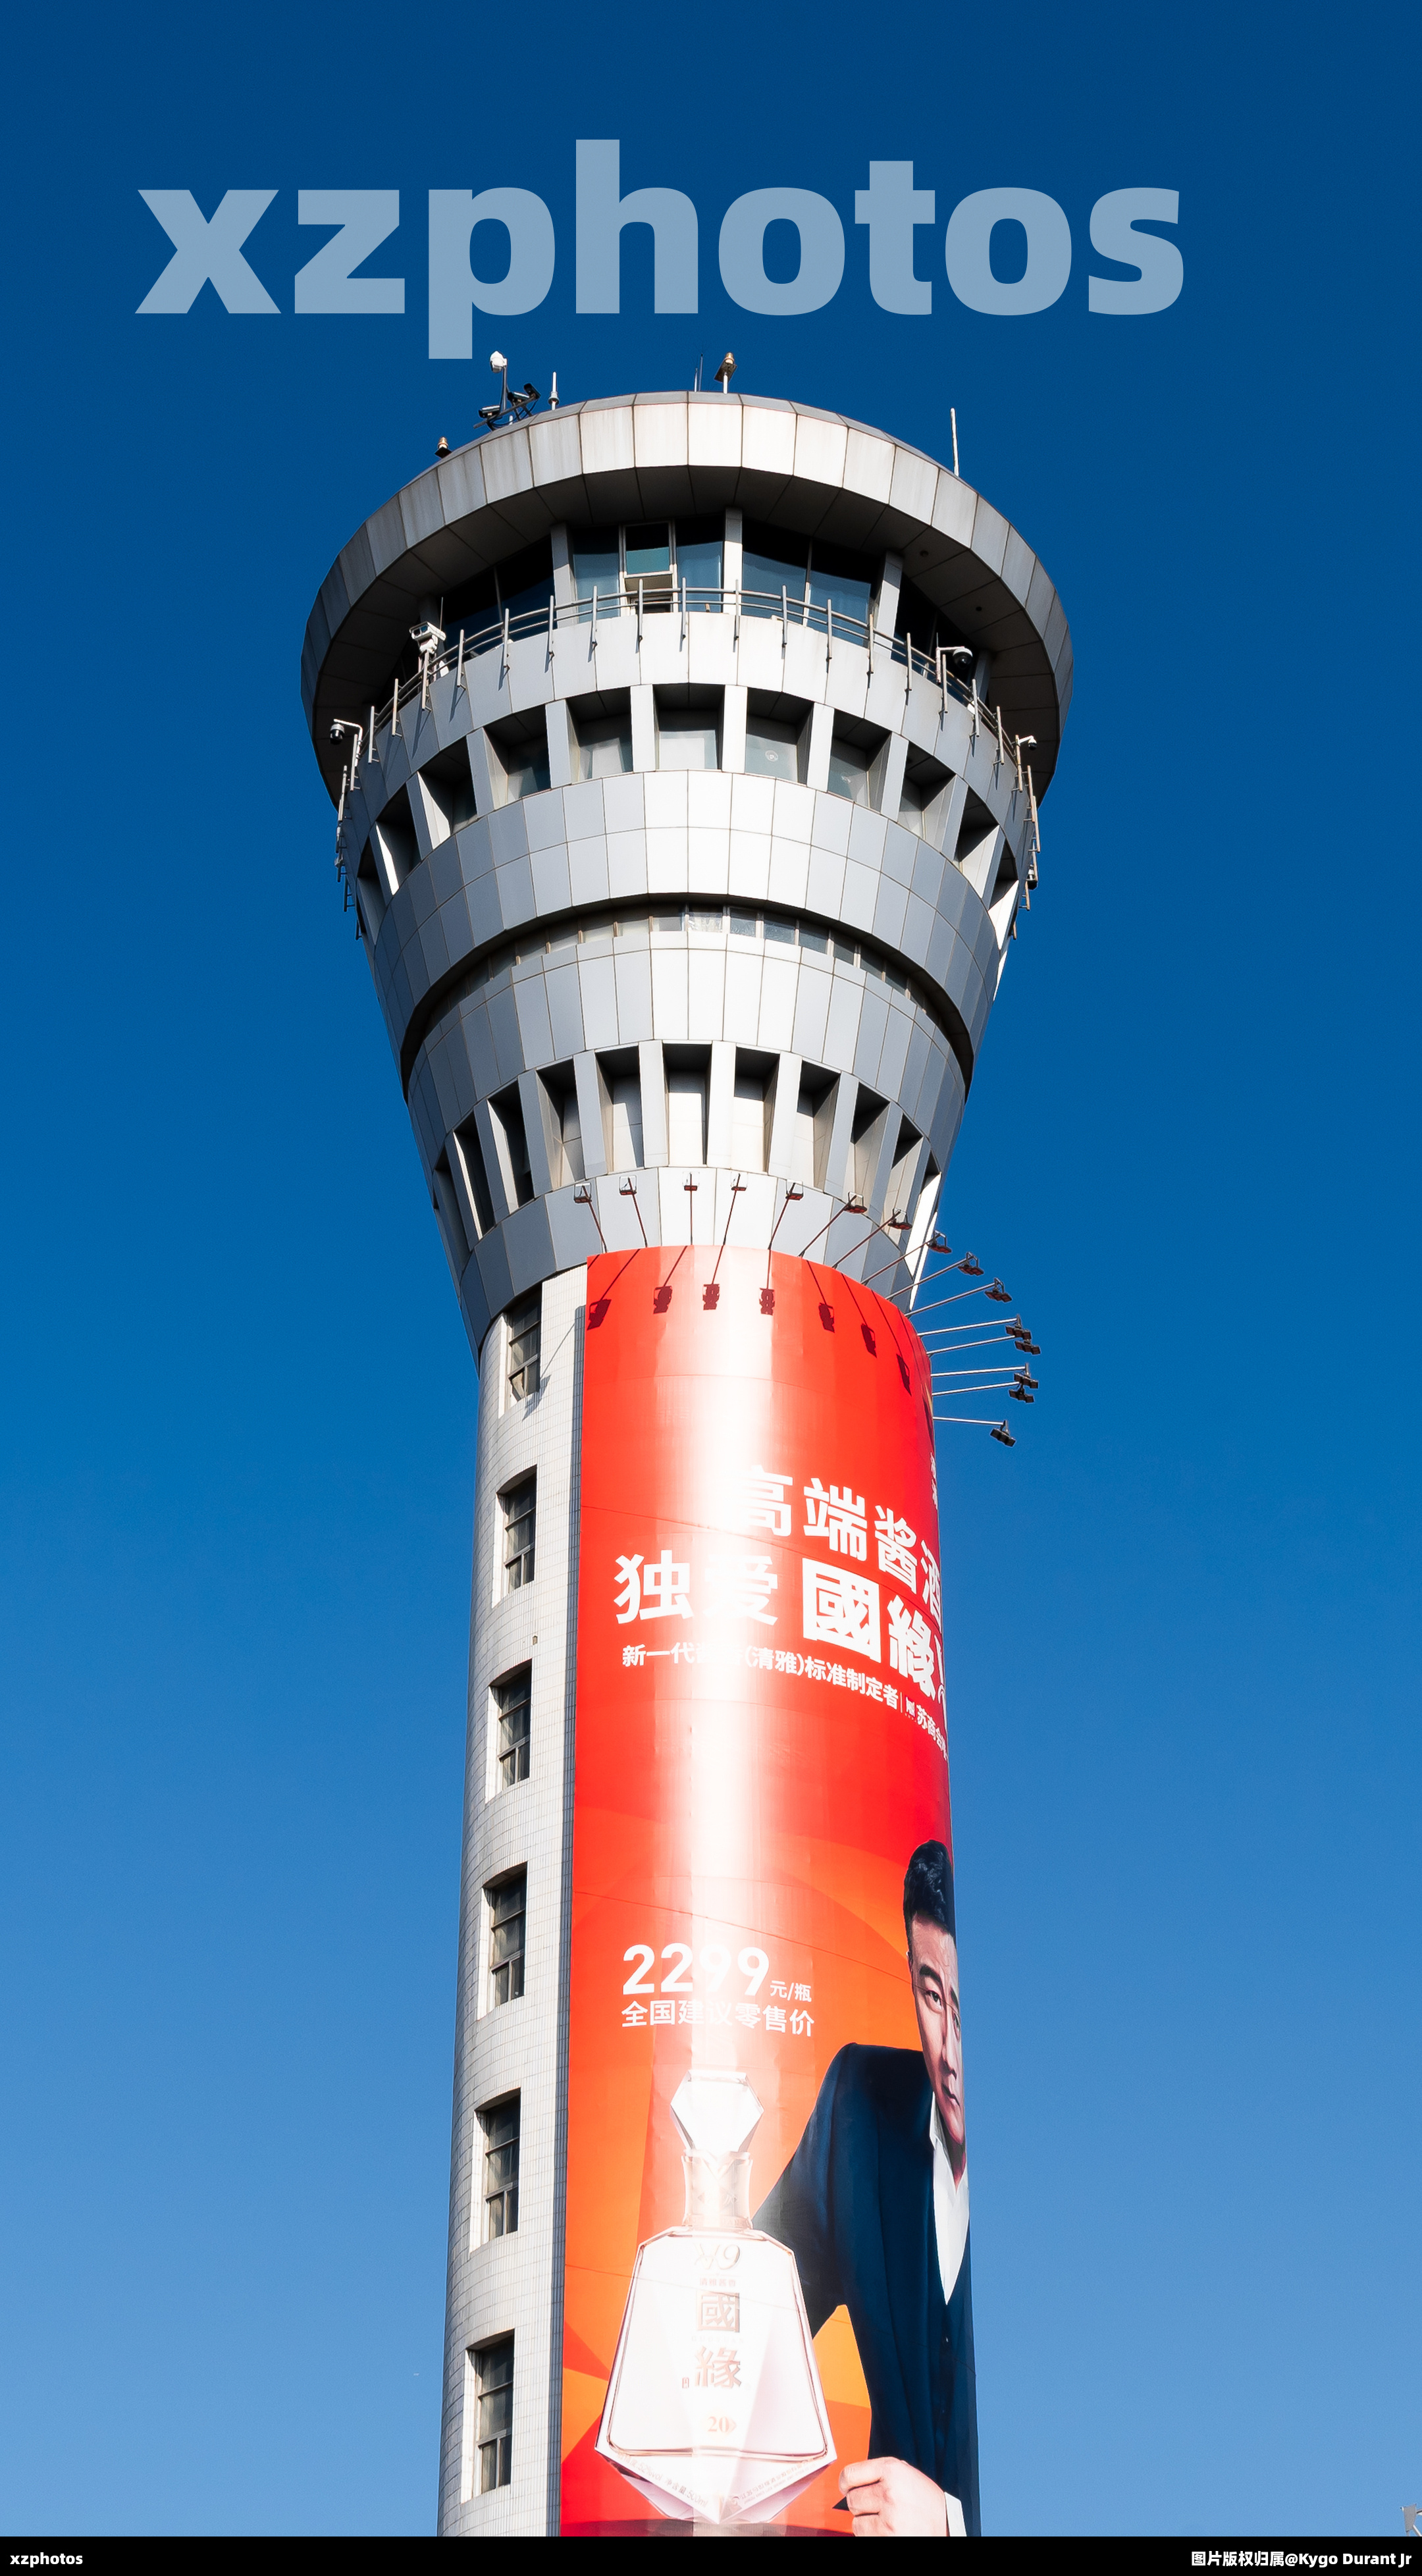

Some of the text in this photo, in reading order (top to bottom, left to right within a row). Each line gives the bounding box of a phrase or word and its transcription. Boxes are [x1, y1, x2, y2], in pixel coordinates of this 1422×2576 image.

[621, 1999, 814, 2037] 全国建议零售价
